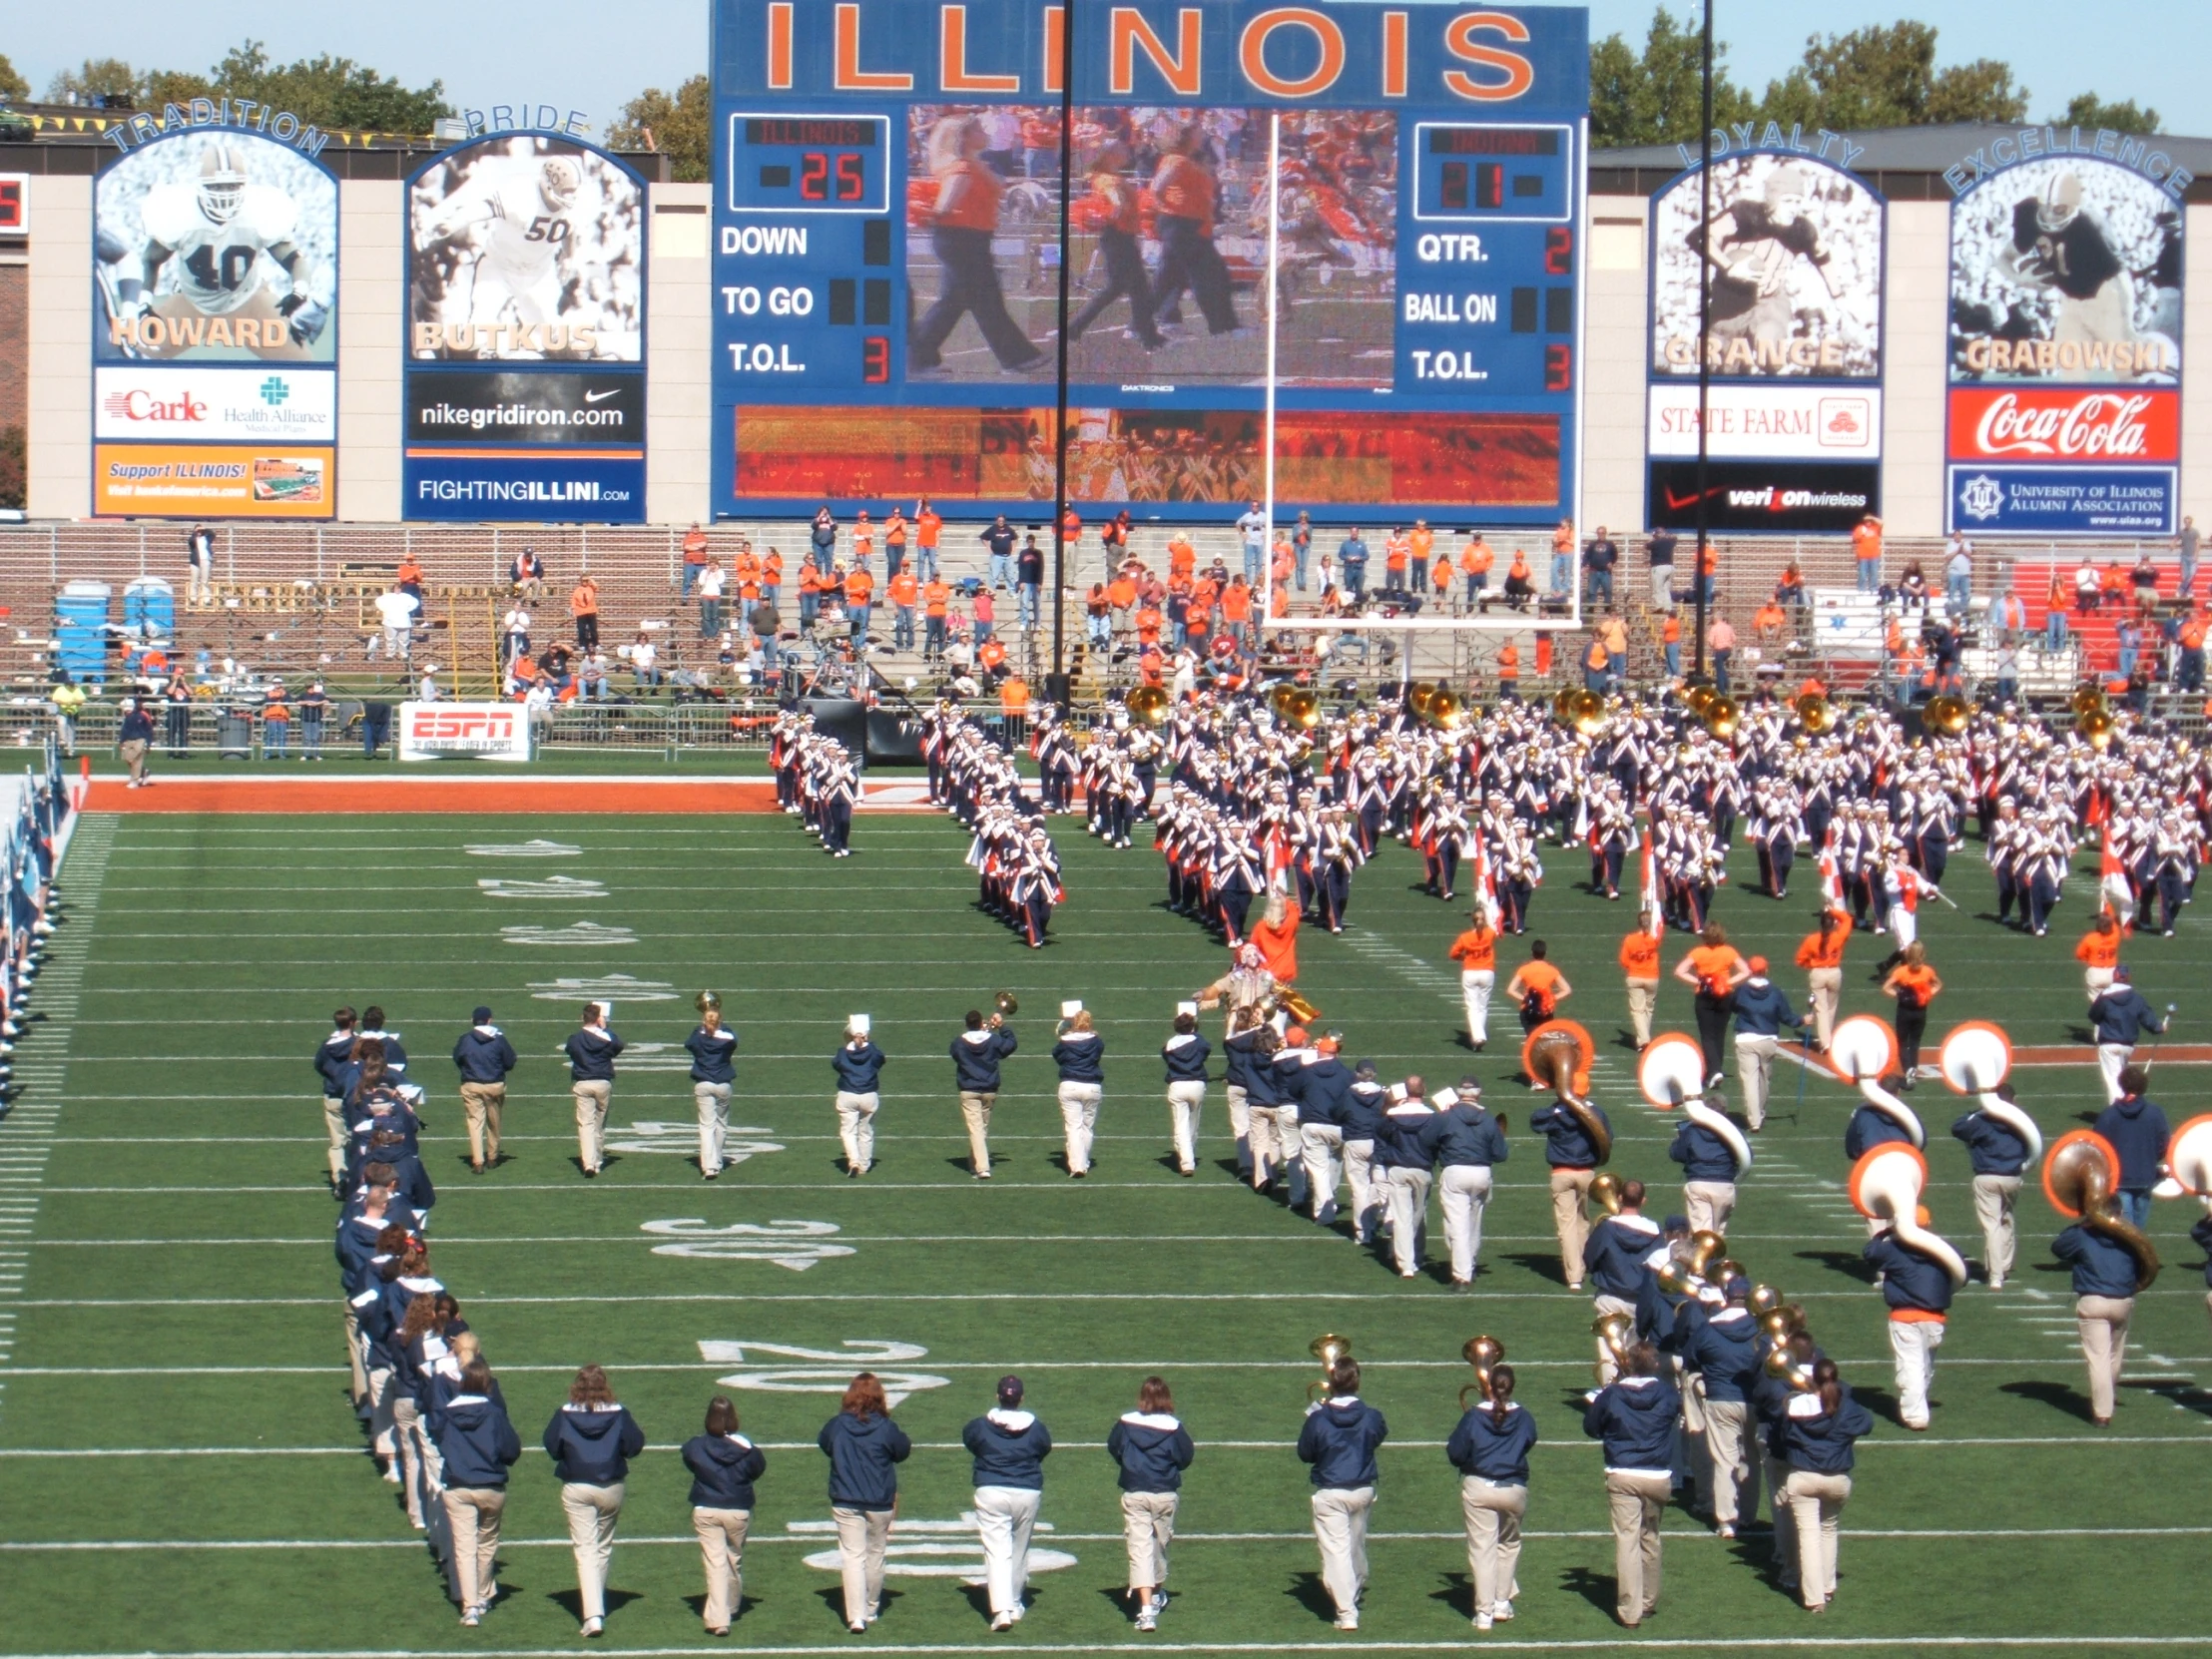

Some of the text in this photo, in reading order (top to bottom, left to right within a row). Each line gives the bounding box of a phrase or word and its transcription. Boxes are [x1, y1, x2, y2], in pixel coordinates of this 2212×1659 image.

[767, 2, 1535, 102] ILLINOIS
[103, 98, 329, 158] TRADITION
[465, 103, 588, 138] PRIDE
[761, 120, 859, 144] ILLINOIS
[1677, 121, 1865, 169] LOYALTY
[801, 153, 863, 200] 25
[1942, 126, 2193, 200] EXCELLENCE
[722, 227, 808, 255] DOWN
[1417, 234, 1488, 262] QTR.
[1545, 227, 1572, 275] 2
[186, 245, 258, 291] 40
[722, 286, 814, 315] TO GO
[1405, 294, 1496, 321] BALL ON
[111, 316, 288, 348] HOWARD
[415, 322, 598, 351] BUTKUS
[729, 343, 806, 371] T.O.L.
[864, 336, 889, 383] 3
[1412, 351, 1488, 379] T.O.L.
[1664, 336, 1844, 366] GRANGE
[1966, 339, 2168, 371] GRABOWSKI
[1545, 344, 1571, 391] 3
[122, 390, 208, 421] Carle
[225, 407, 326, 423] Health Alliance
[421, 403, 624, 429] nikegridiron.com
[1660, 407, 1813, 434] STATE FARM
[1976, 392, 2153, 454] Coca-Cola
[110, 463, 247, 480] Support ILLINOIS!
[2010, 484, 2164, 498] UNIVERSITY OF ILLINOIS
[2010, 499, 2163, 512] ALUMNI ASSOCIATION
[412, 712, 513, 738] ESPN
